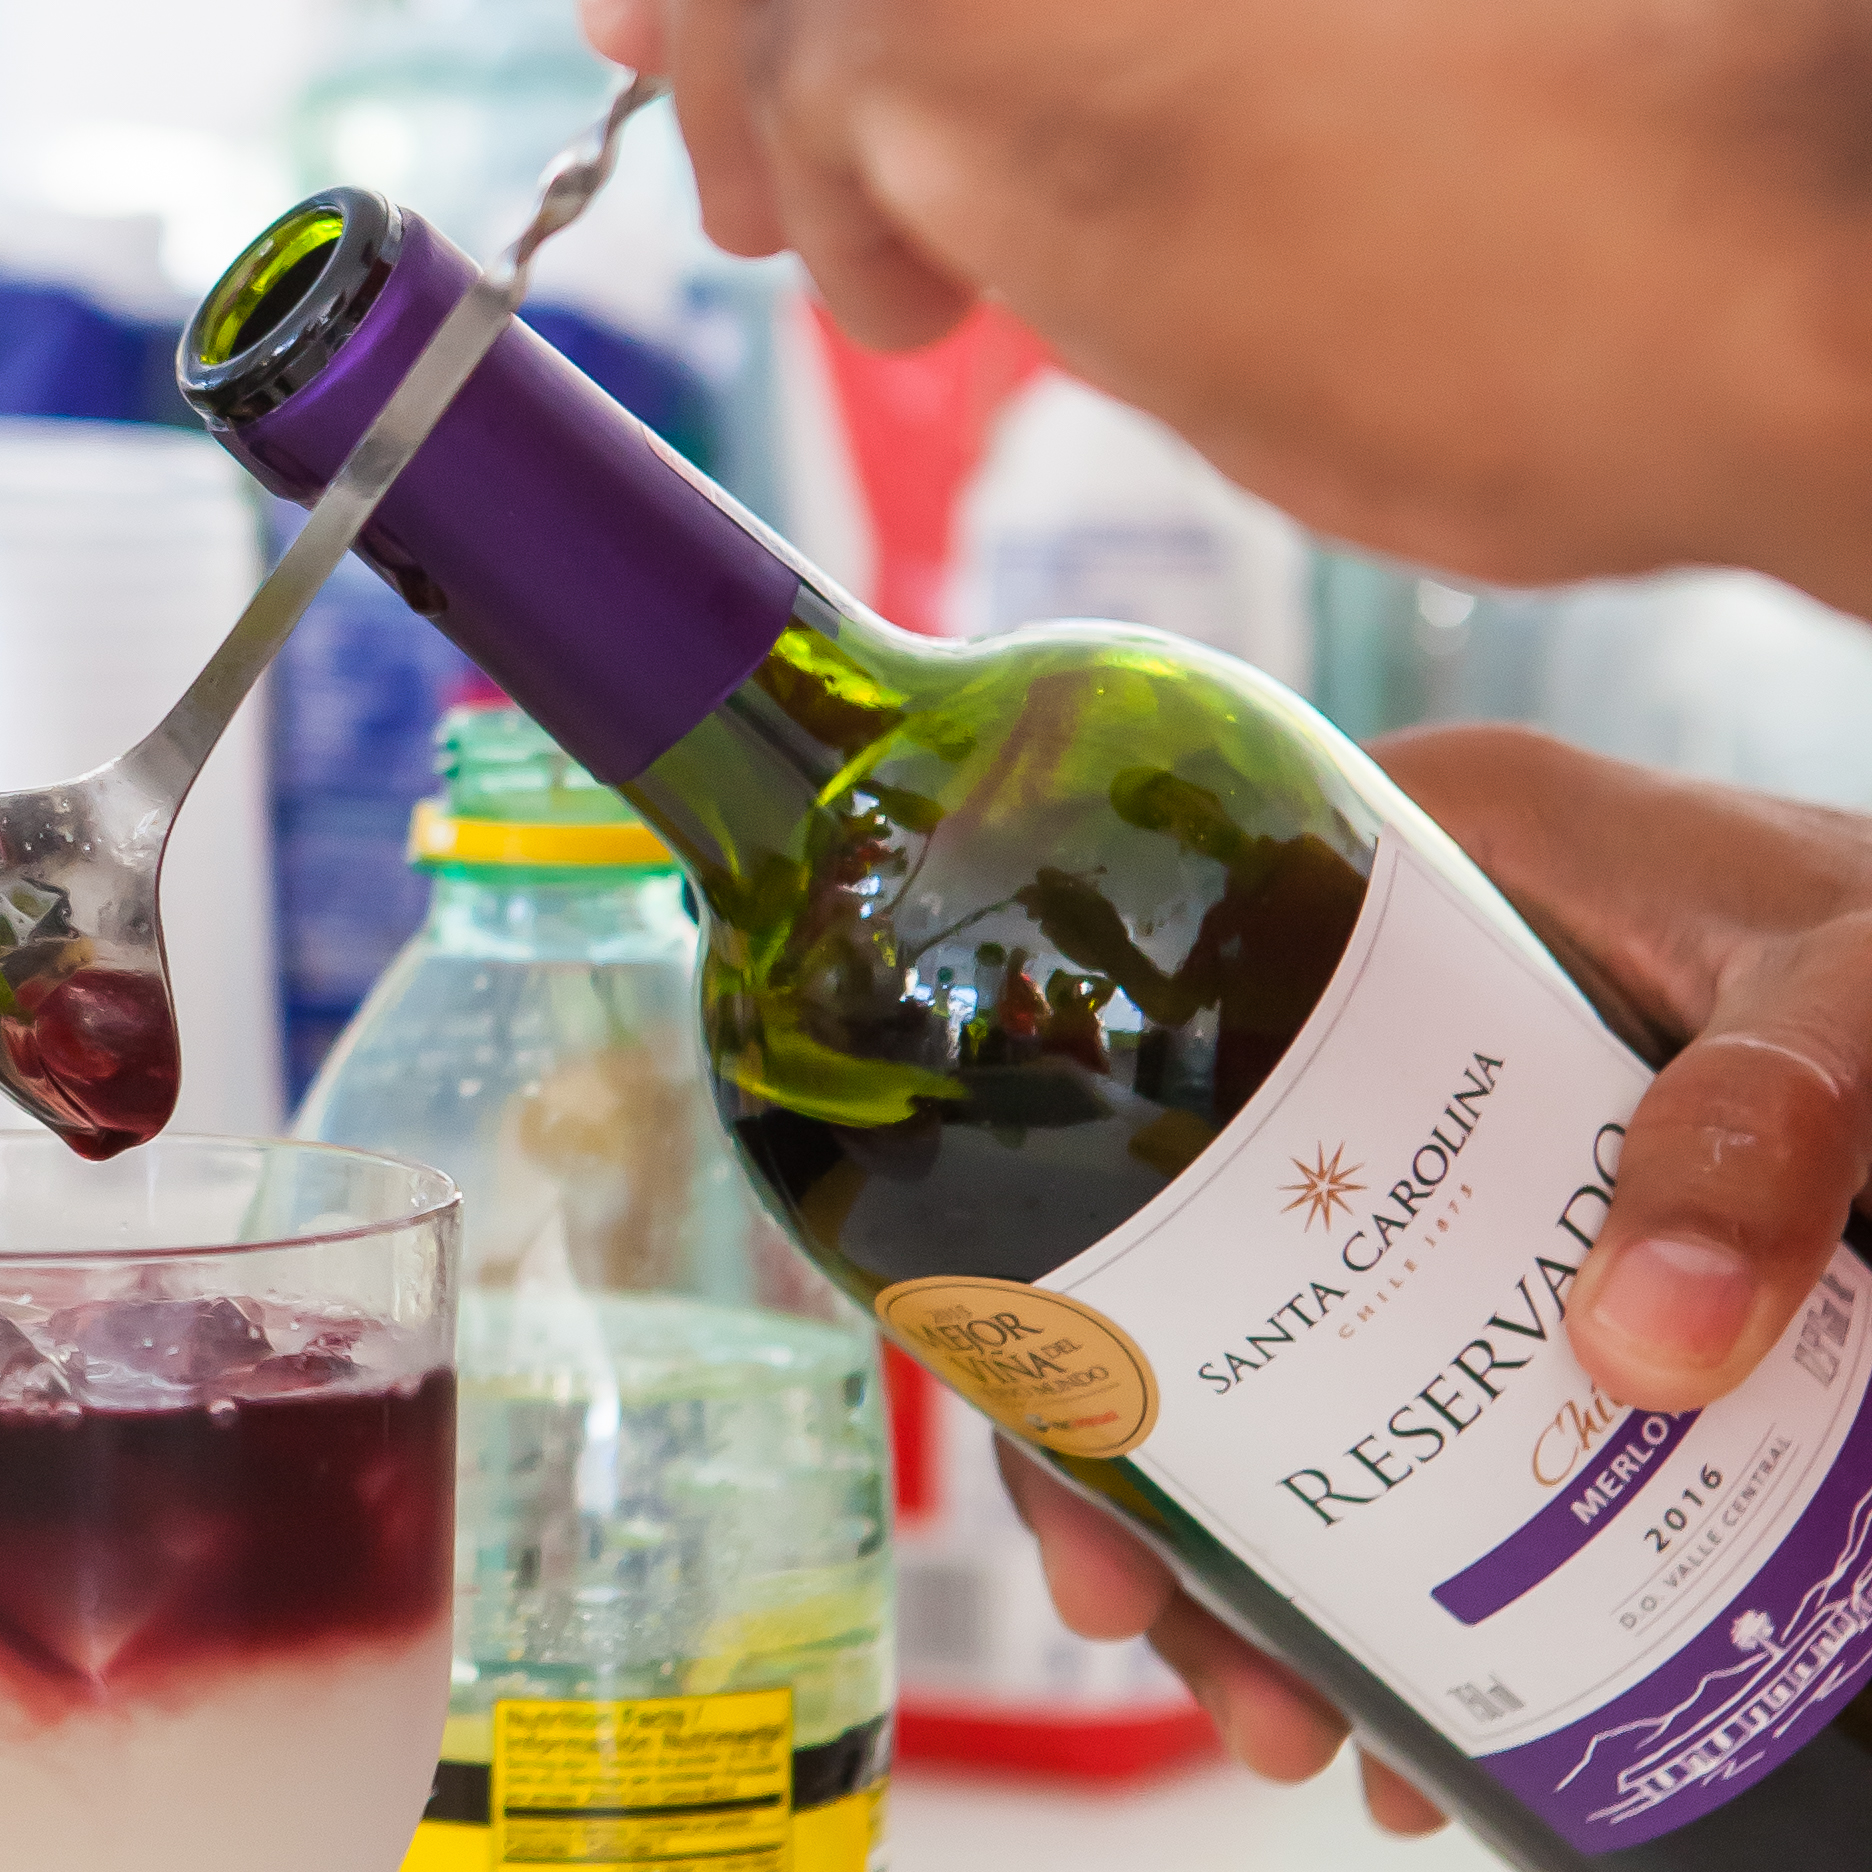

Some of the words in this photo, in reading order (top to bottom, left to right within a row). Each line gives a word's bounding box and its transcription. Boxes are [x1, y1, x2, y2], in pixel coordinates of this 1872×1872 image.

[1197, 1281, 1350, 1395] SANTA
[1341, 1052, 1506, 1273] CAROLINA
[1337, 1257, 1418, 1340] CHILE
[1569, 1413, 1680, 1526] MERLO
[1642, 1462, 1724, 1554] 2016
[1663, 1528, 1723, 1589] VALLE
[1722, 1436, 1793, 1528] CENTRAL
